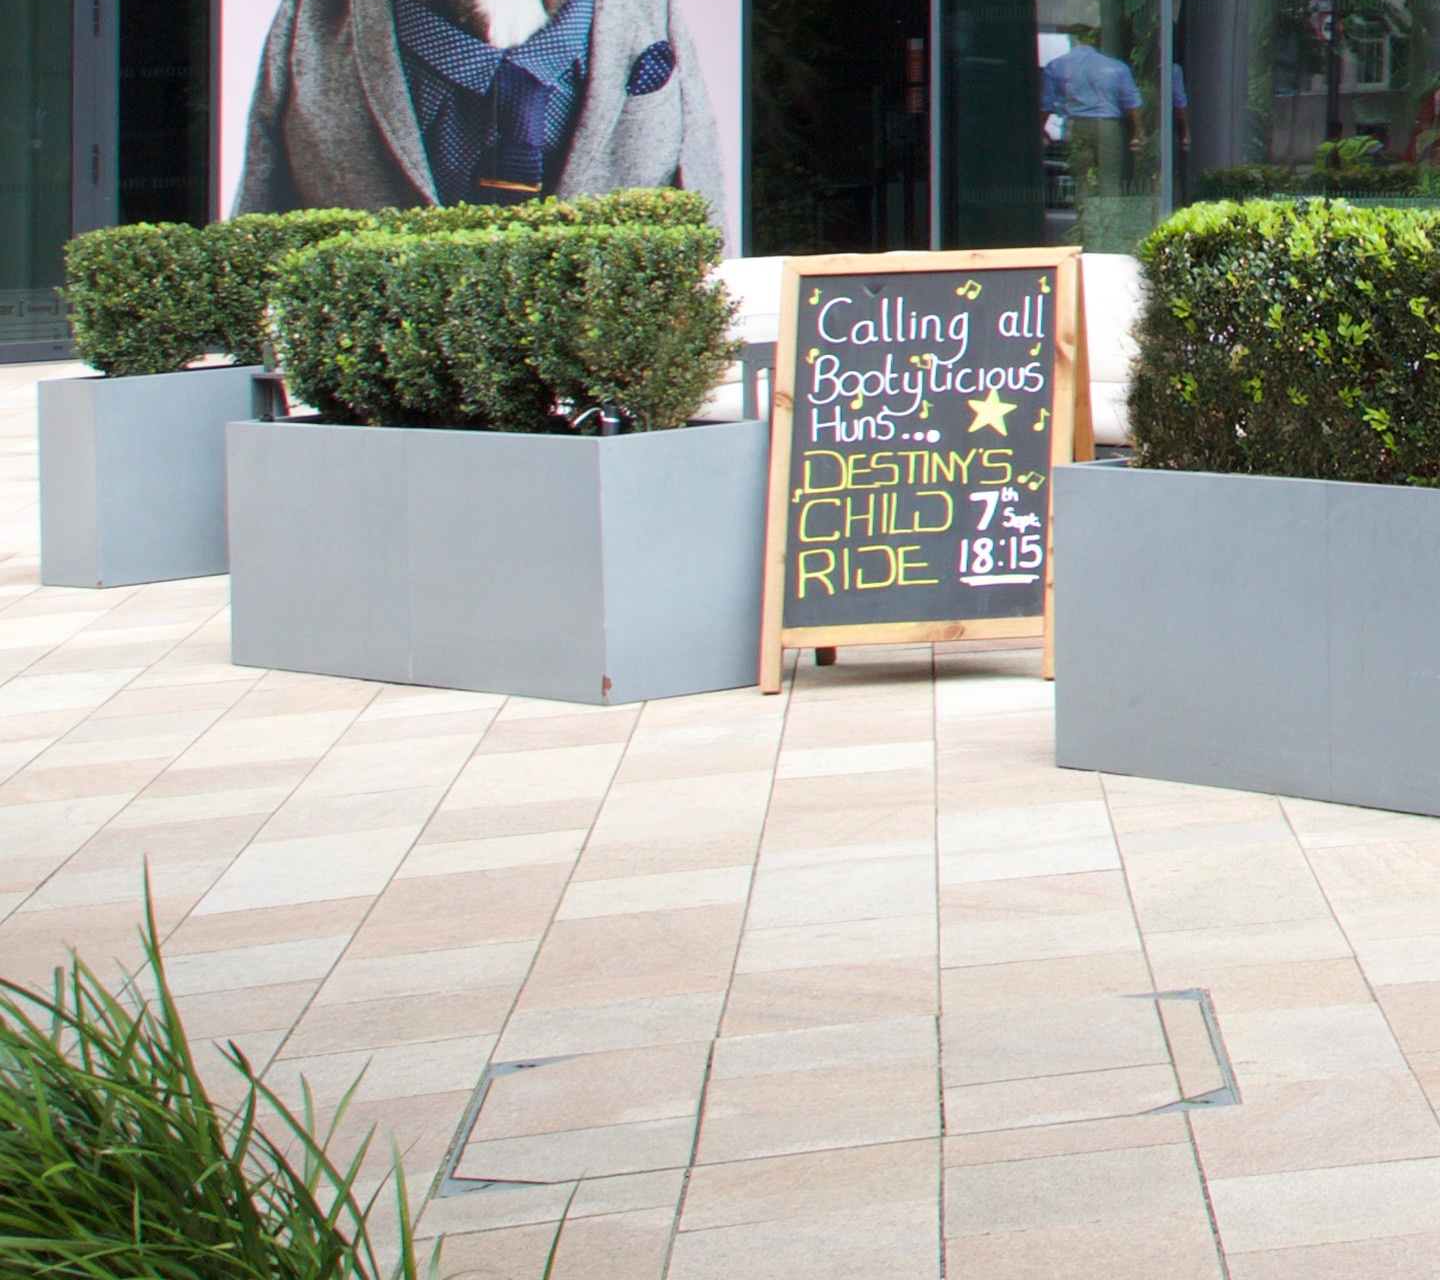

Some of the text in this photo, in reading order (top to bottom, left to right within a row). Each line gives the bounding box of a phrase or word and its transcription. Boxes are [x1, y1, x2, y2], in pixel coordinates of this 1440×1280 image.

[818, 294, 1045, 364] Calling all
[807, 352, 1045, 416] Bootylicious
[803, 447, 1015, 494] DESTINY'S
[800, 490, 954, 544] CHILD
[798, 536, 1043, 599] RIDE 18:15
